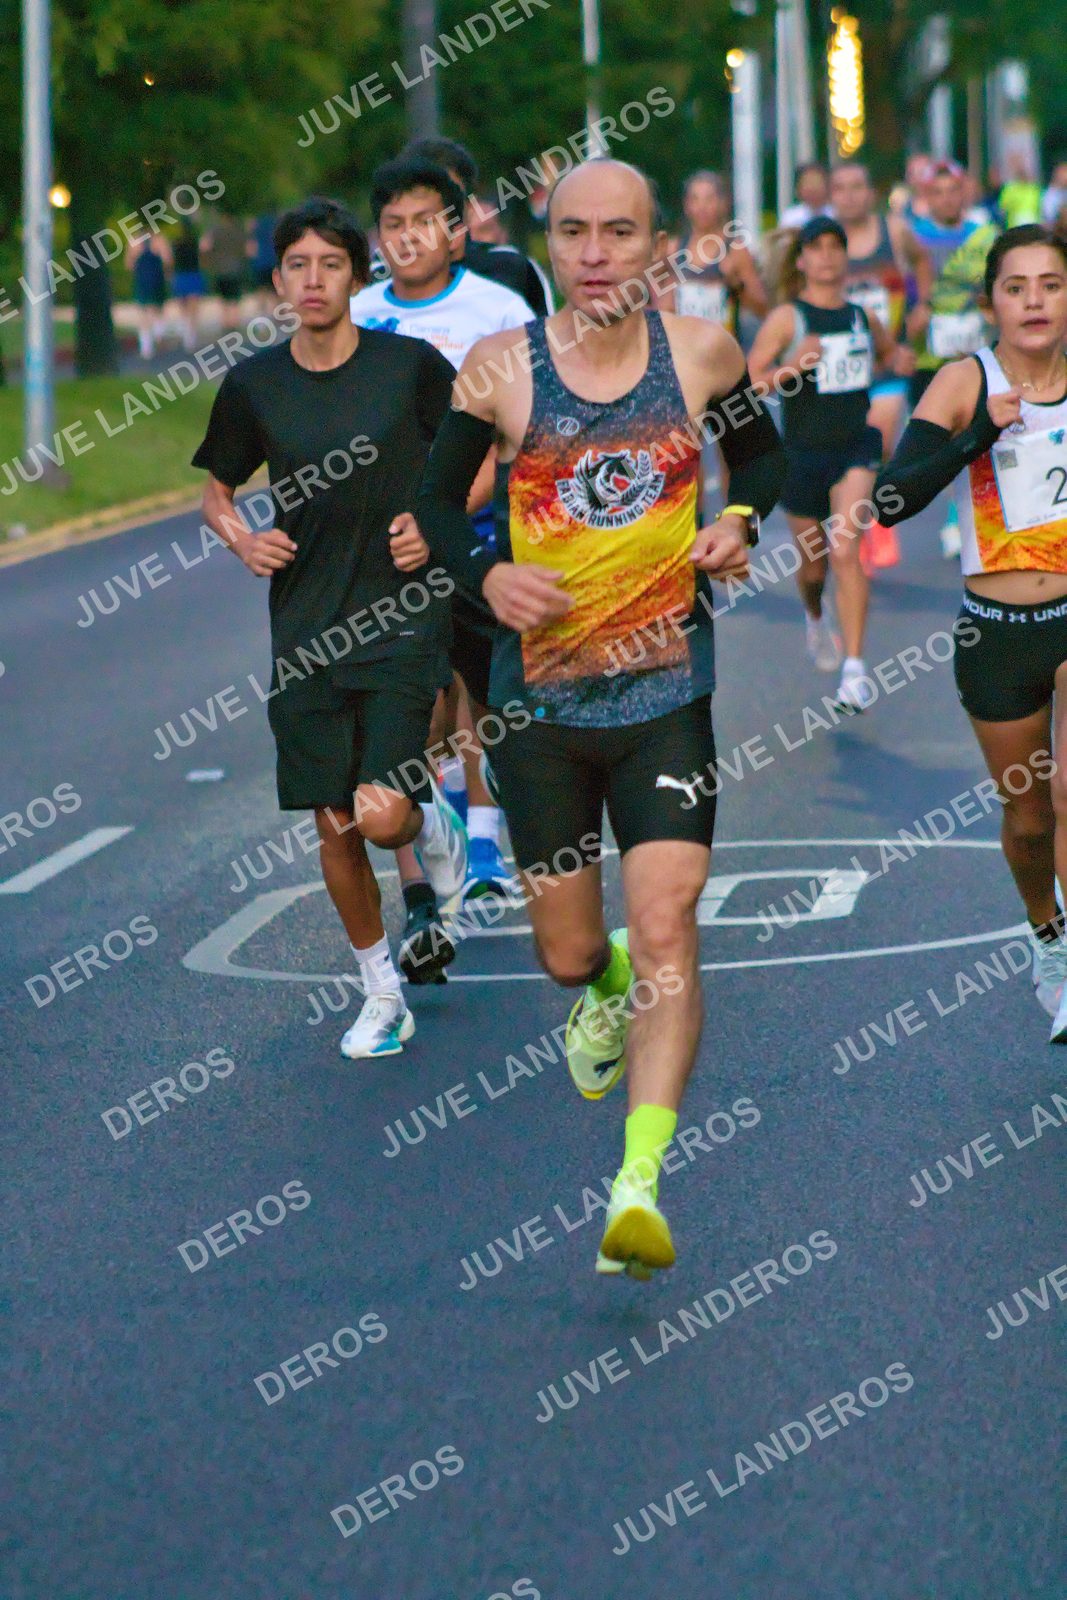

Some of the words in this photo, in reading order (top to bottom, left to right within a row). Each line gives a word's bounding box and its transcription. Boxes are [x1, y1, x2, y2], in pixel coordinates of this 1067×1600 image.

[588, 504, 644, 527] RUNNING
[642, 474, 665, 506] TEAM
[1046, 466, 1067, 506] 2
